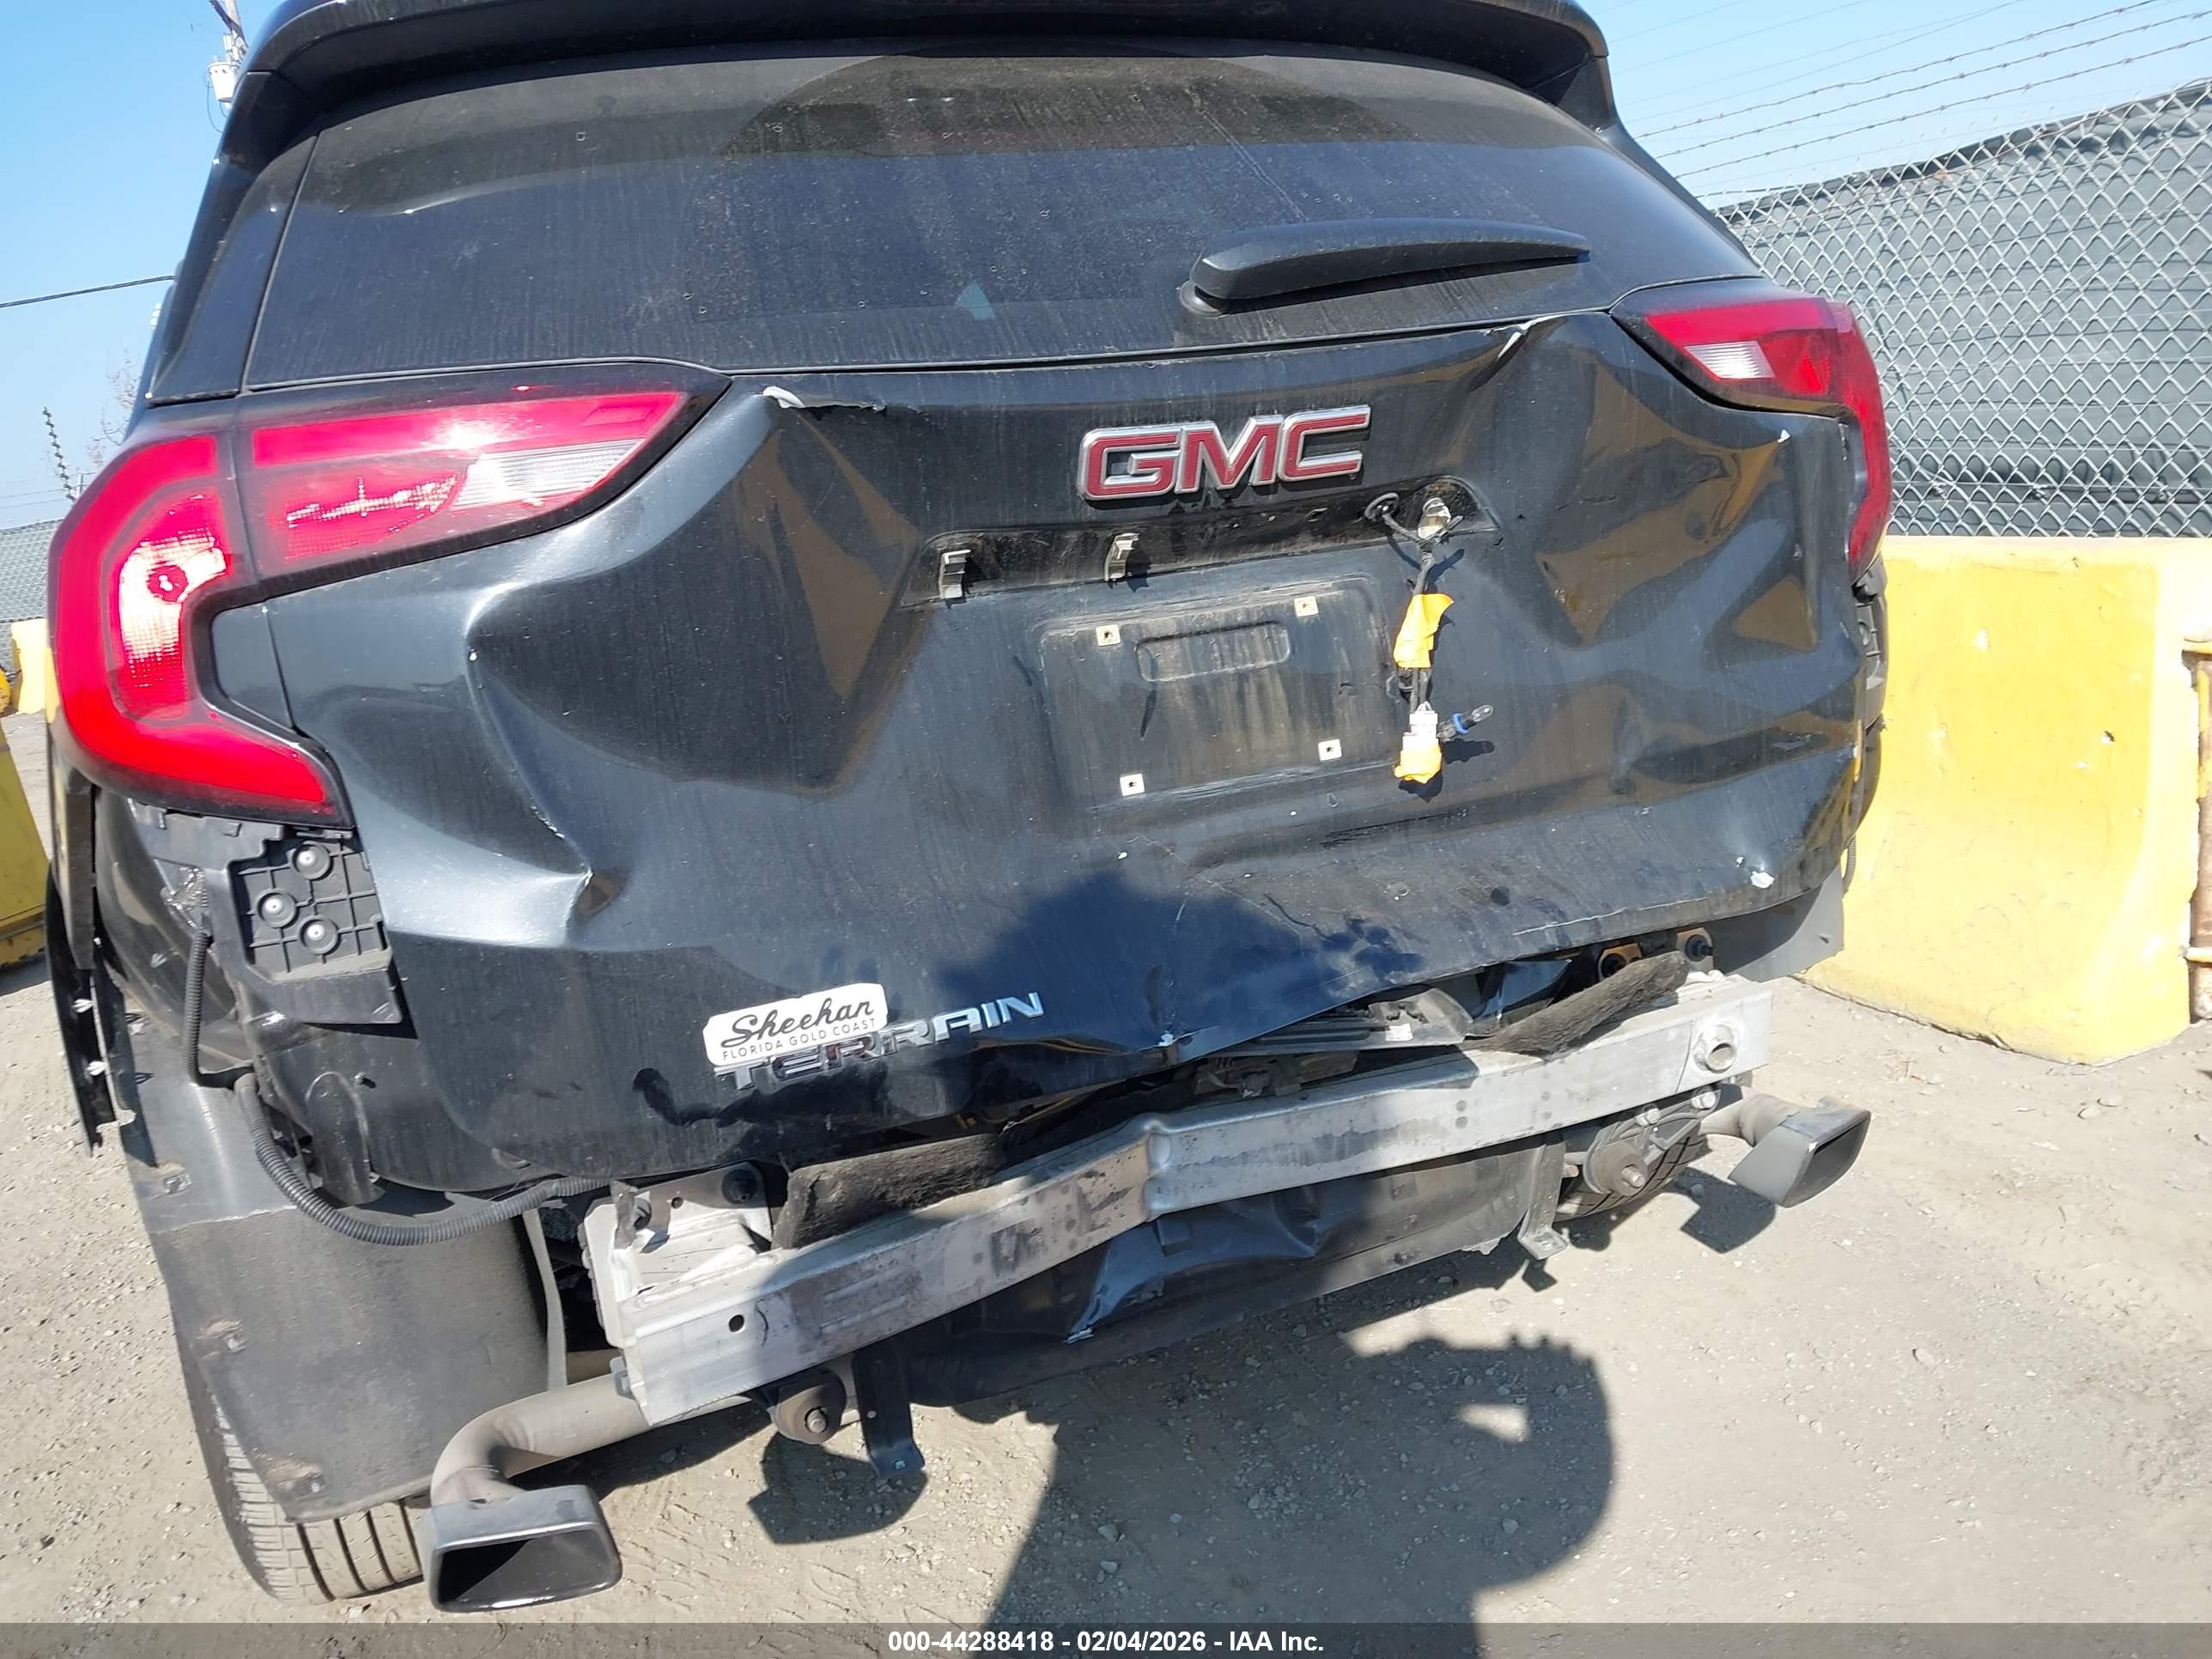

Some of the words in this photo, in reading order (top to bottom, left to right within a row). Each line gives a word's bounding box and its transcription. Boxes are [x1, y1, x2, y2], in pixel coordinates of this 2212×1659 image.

[1078, 404, 1371, 501] GMC
[714, 991, 1045, 1091] TERRAIN
[720, 997, 874, 1048] Sheehan
[722, 1039, 783, 1060] FLORIDA
[788, 1030, 827, 1047] GOLD
[832, 1018, 875, 1036] COAST
